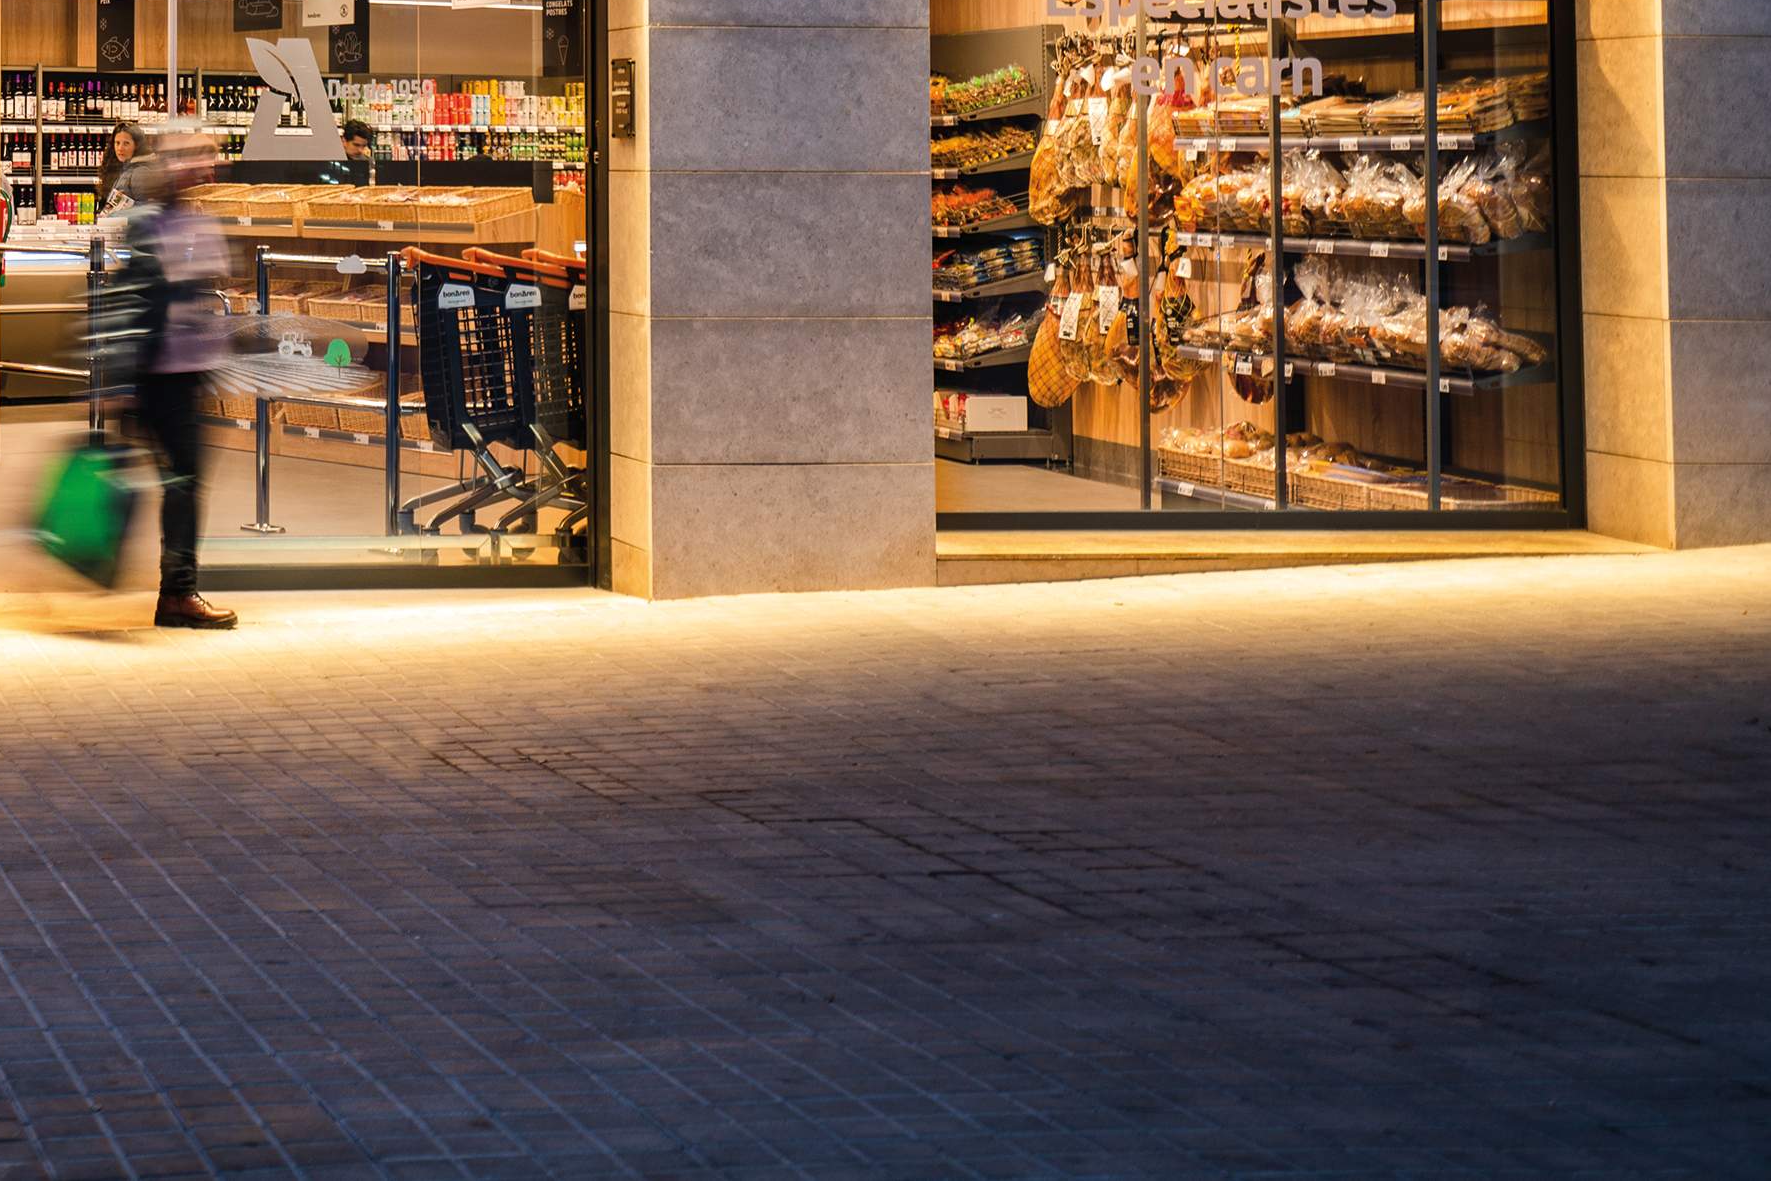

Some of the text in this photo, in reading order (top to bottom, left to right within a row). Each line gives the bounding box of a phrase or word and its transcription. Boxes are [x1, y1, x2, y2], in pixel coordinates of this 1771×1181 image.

[546, 0, 573, 8] CONGELATS
[1132, 56, 1323, 98] en carn
[328, 78, 434, 100] Des de 1959
